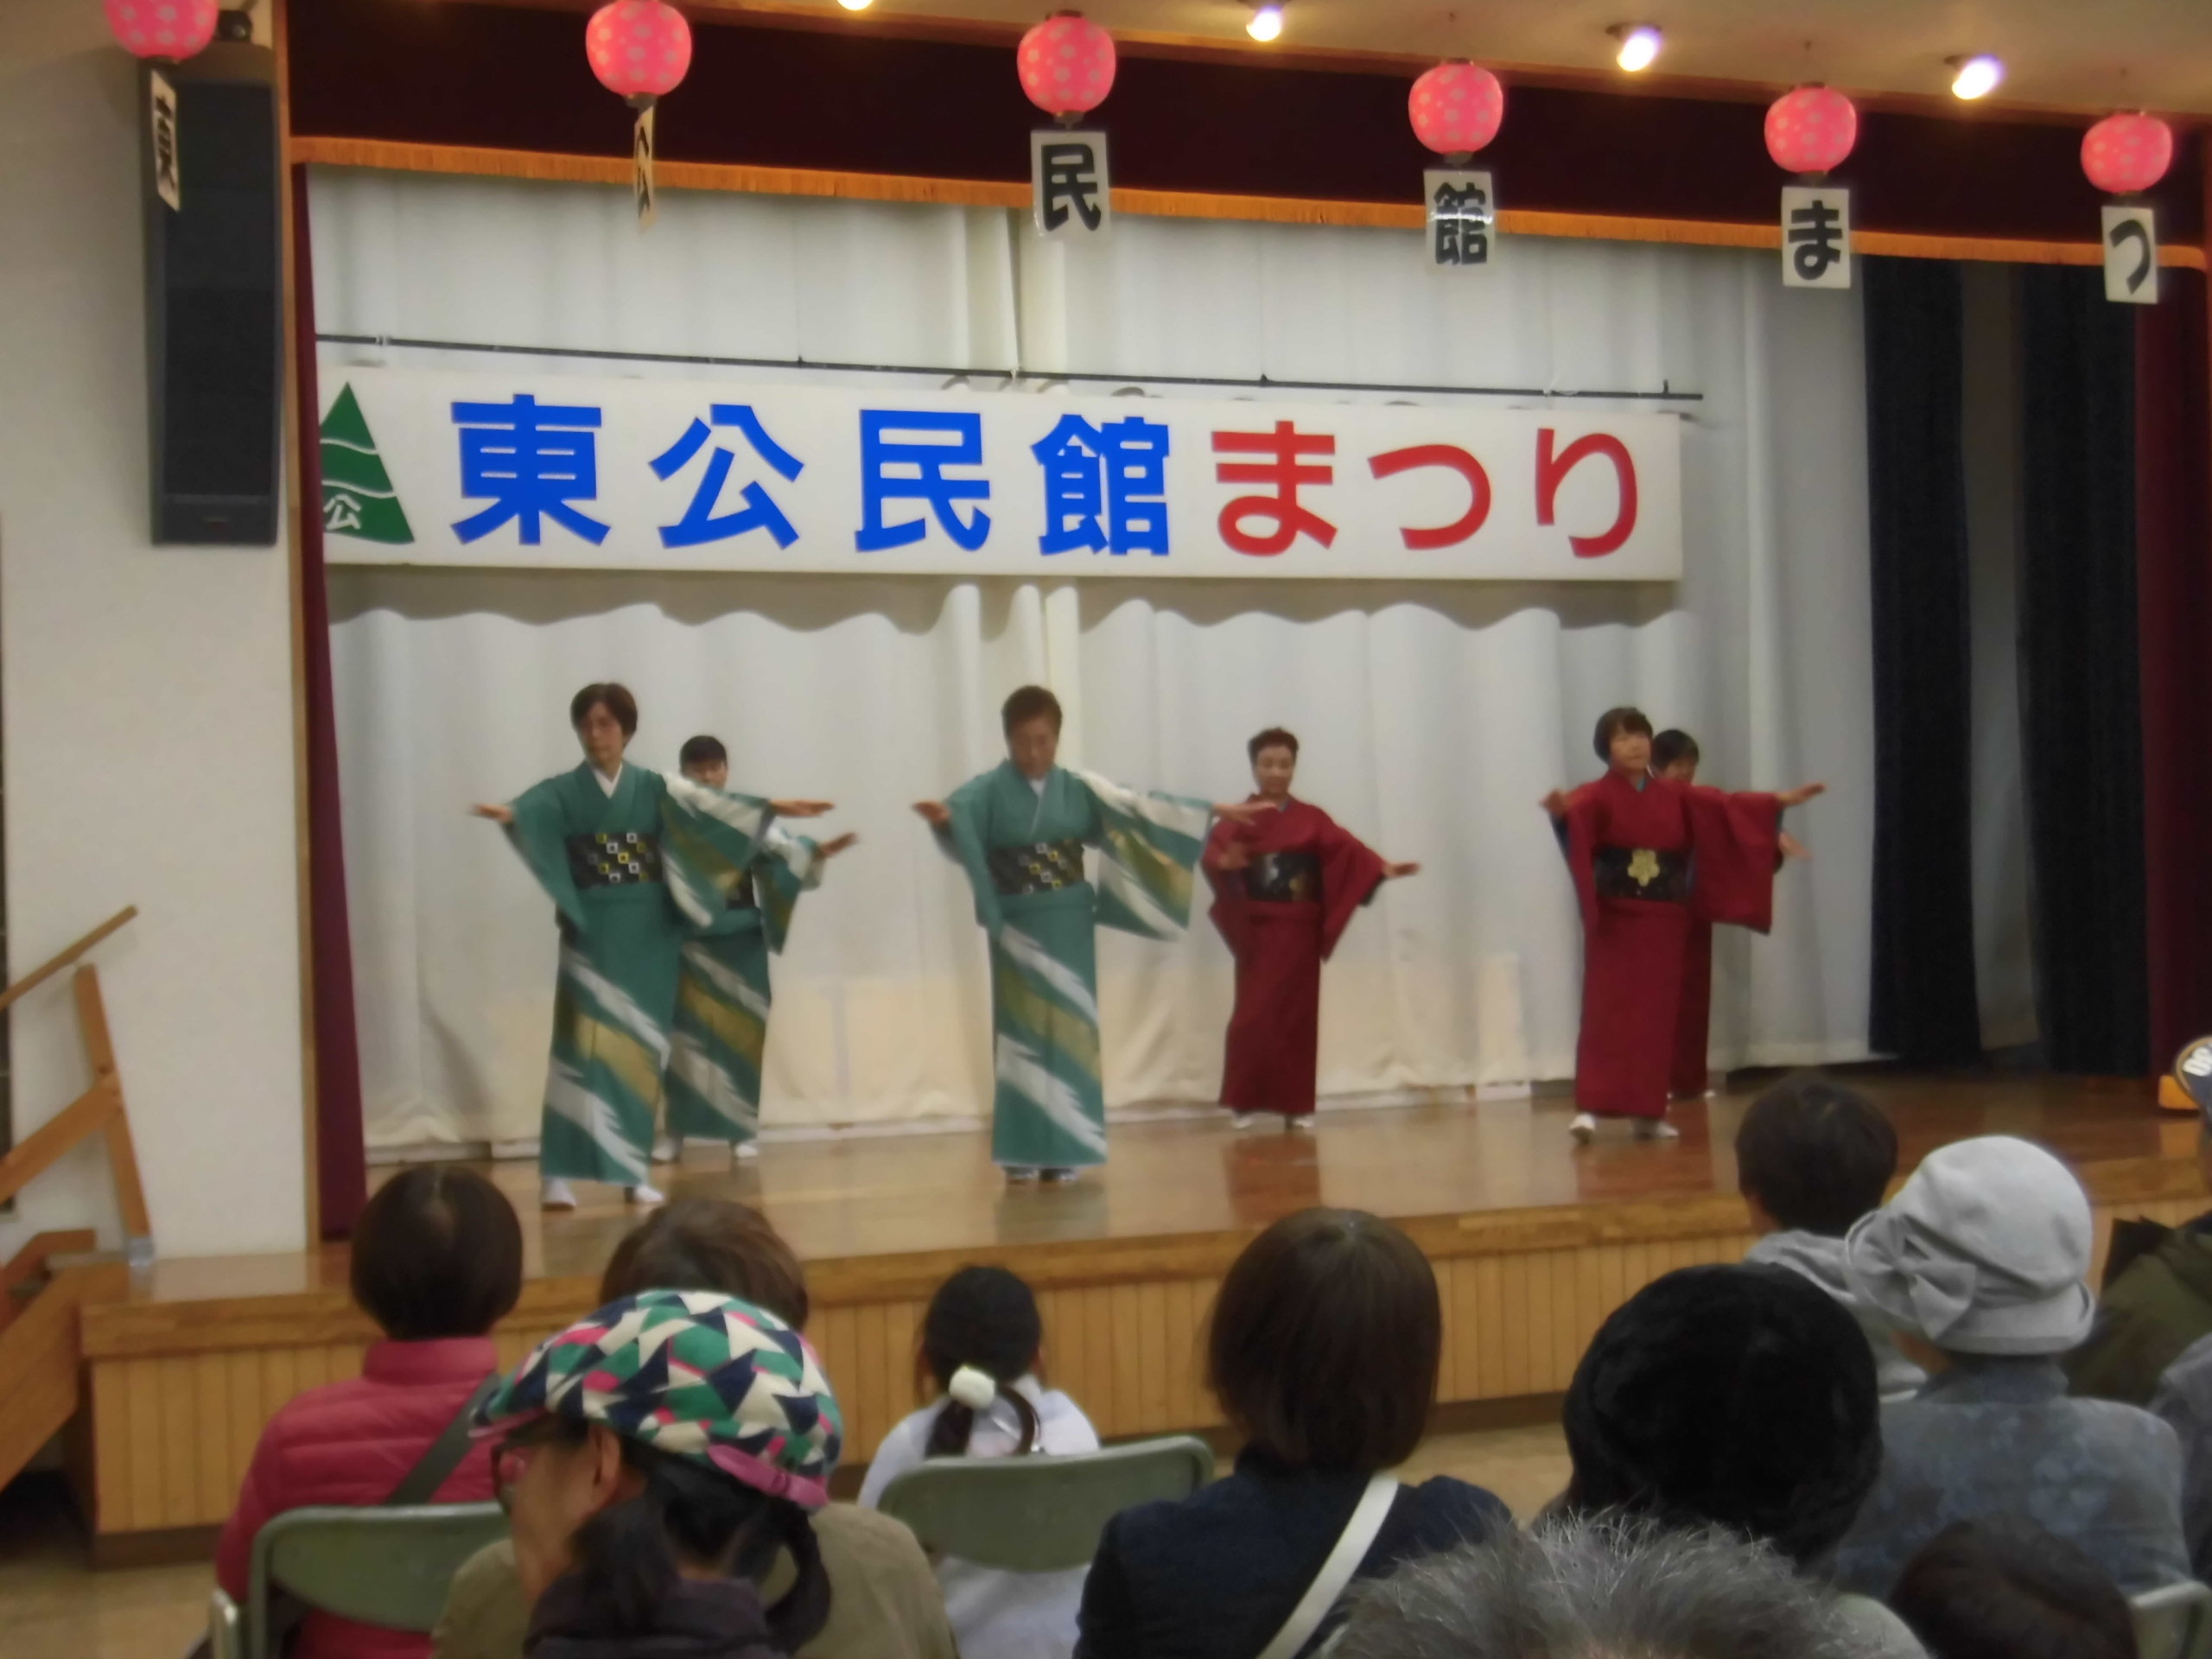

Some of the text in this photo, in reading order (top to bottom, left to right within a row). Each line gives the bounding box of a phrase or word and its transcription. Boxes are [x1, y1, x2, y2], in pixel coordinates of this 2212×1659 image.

[1040, 143, 1102, 232] 民
[1433, 181, 1488, 265] 館
[1788, 200, 1843, 281] ま
[2109, 219, 2152, 296] つ
[322, 493, 361, 531] 公
[450, 393, 1638, 559] 東公民館まつり
